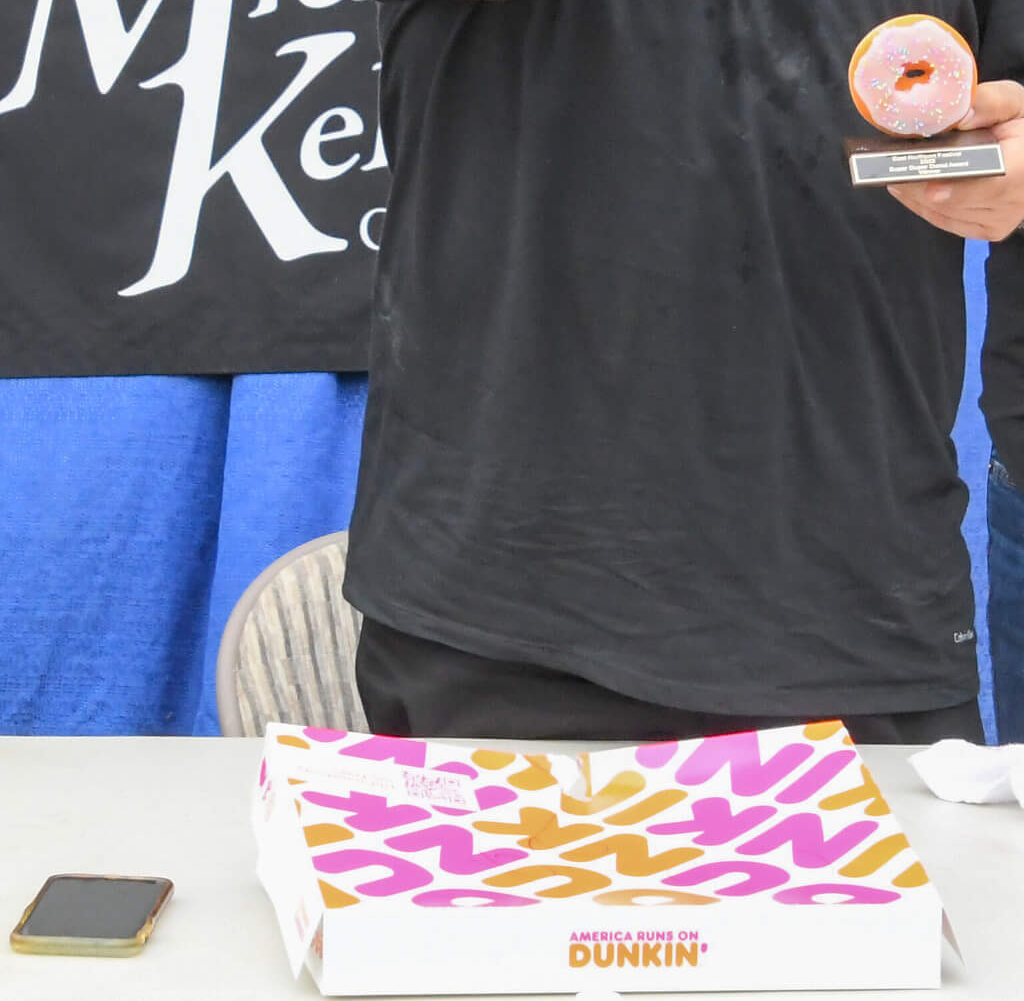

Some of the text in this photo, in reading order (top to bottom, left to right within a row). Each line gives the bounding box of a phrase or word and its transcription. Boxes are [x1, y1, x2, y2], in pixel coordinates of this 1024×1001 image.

[569, 931, 699, 942] AMERICA RUNS ON
[569, 942, 708, 968] DUNKIN'
